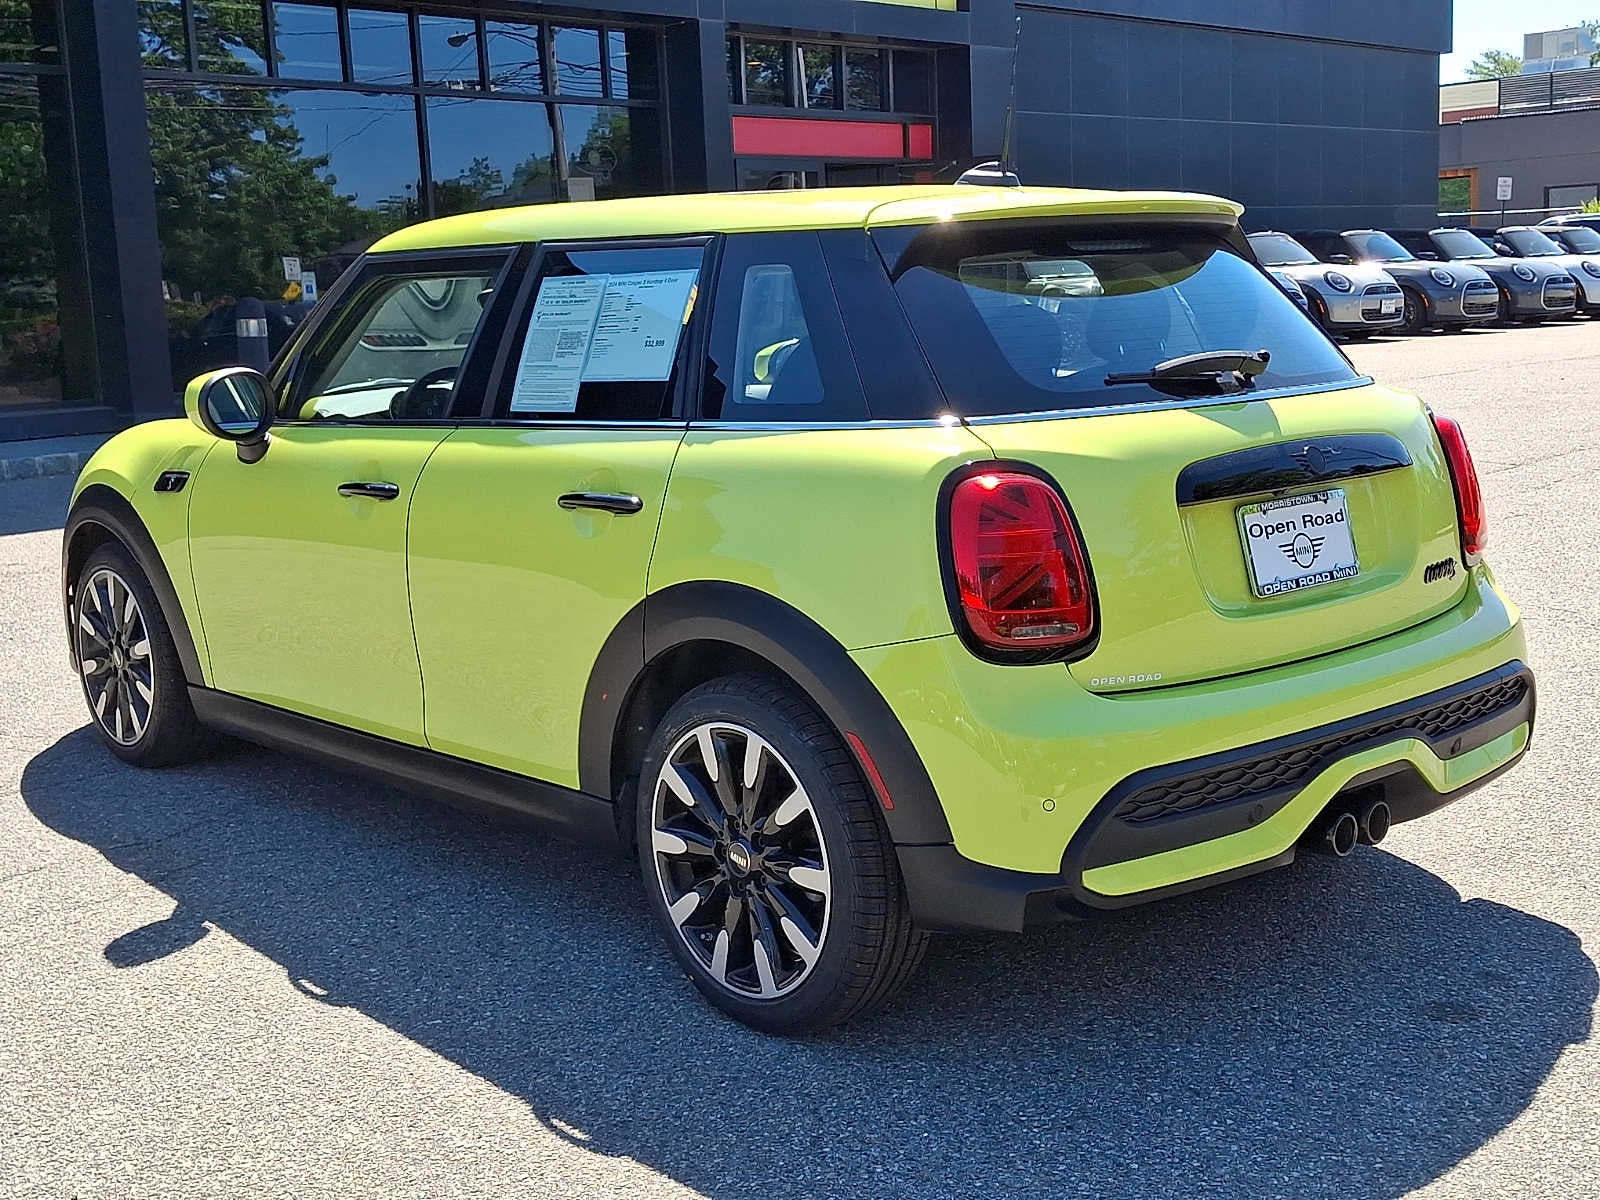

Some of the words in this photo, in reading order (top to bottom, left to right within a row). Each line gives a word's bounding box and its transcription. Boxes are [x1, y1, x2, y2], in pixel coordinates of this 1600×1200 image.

[1317, 492, 1328, 501] NJ
[1249, 520, 1297, 540] Open
[1301, 508, 1345, 529] Road
[1295, 544, 1313, 557] MINI
[1263, 579, 1297, 595] OPEN
[1299, 572, 1331, 588] ROAD
[1332, 566, 1357, 579] MINI
[1090, 676, 1125, 686] OPEN
[1128, 673, 1162, 684] ROAD
